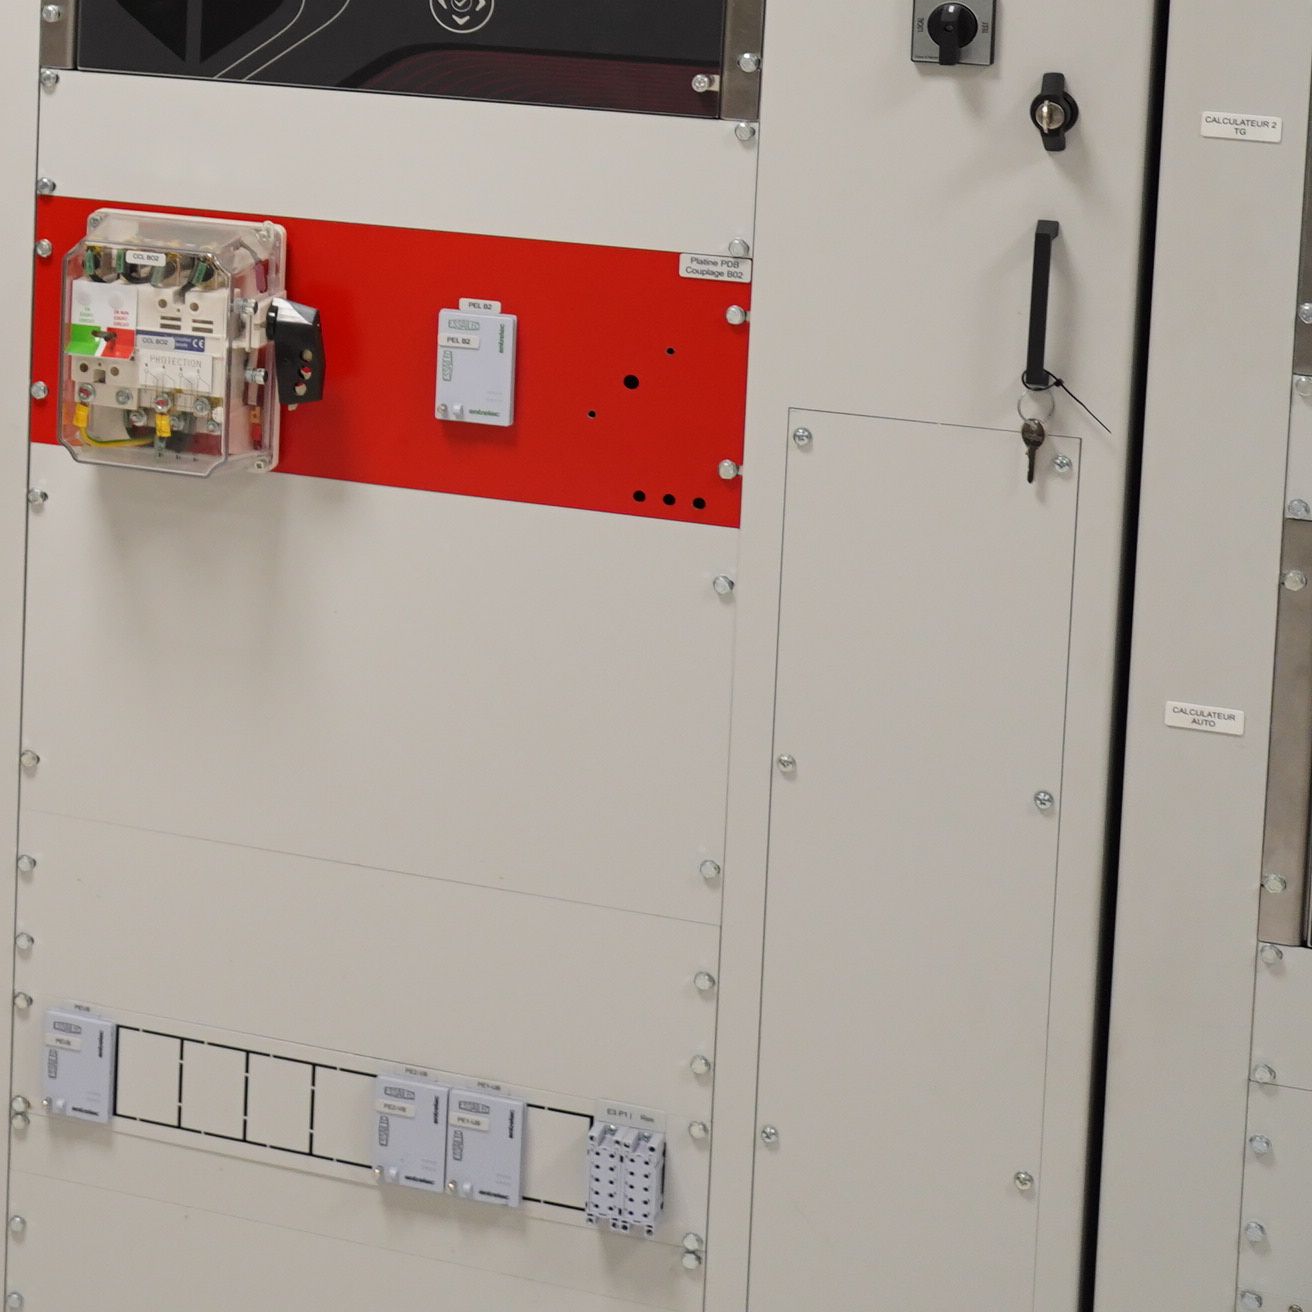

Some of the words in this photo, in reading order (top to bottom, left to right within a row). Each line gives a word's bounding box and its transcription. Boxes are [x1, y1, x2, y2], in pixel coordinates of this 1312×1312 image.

[1205, 116, 1270, 128] CALCULATEUR
[1271, 121, 1277, 129] 2
[1234, 127, 1246, 136] TG
[690, 257, 717, 266] Platine
[721, 259, 740, 268] PDB
[685, 267, 725, 278] Couplage
[1172, 706, 1236, 721] CALCULATEUR
[1191, 718, 1216, 727] AUTO
